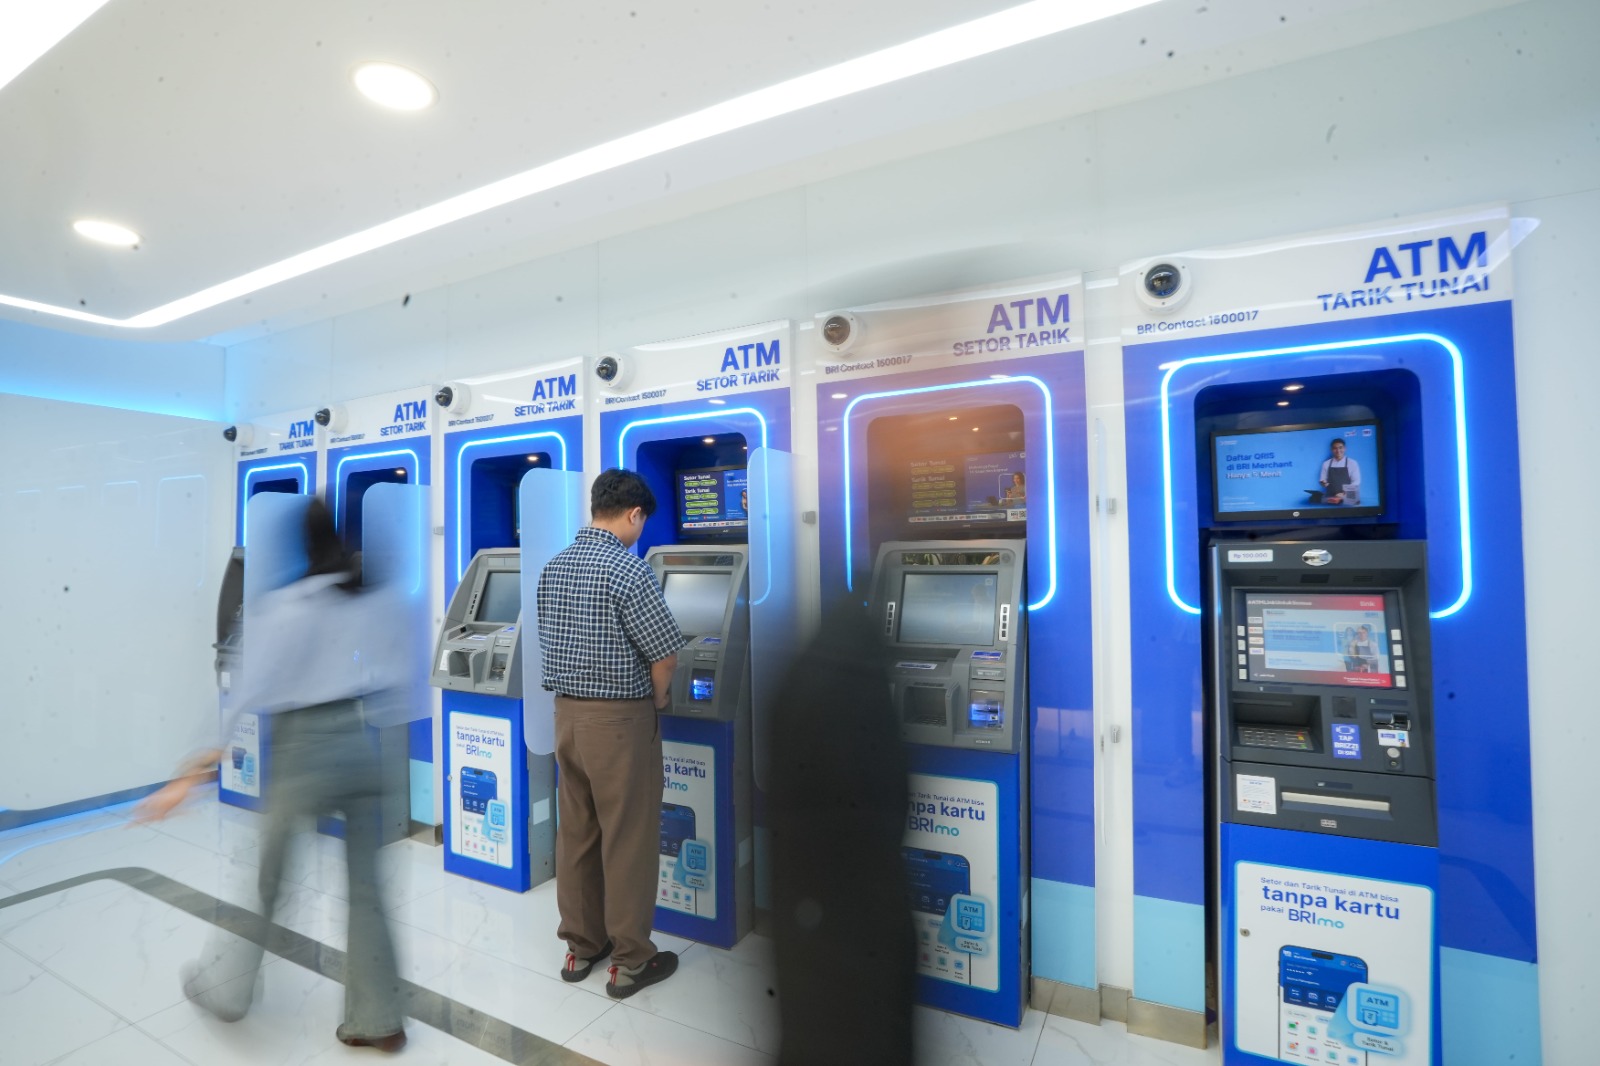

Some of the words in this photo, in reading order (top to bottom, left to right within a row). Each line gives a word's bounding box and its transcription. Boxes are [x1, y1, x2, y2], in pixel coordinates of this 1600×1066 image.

[1364, 231, 1488, 283] ATM
[1317, 285, 1393, 312] TARIK
[1401, 272, 1490, 300] TUNAI
[987, 294, 1070, 334] ATM
[1137, 324, 1156, 334] BRI
[1158, 318, 1206, 332] Contact
[953, 336, 1010, 357] SETOR
[1015, 328, 1071, 349] TARIK
[720, 339, 780, 373] ATM
[825, 365, 839, 374] BRI
[840, 361, 874, 373] Contact
[532, 374, 576, 401] ATM
[696, 375, 738, 392] SETOR
[742, 369, 780, 385] TARIK
[393, 400, 426, 422] ATM
[514, 403, 545, 417] SETOR
[547, 399, 576, 412] TARIK
[288, 420, 314, 439] ATM
[380, 425, 403, 436] SETOR
[405, 421, 426, 432] TARIK
[1226, 454, 1251, 462] Daftar
[1254, 452, 1275, 460] QRIS
[1252, 461, 1293, 469] Merchant
[456, 731, 480, 744] tanpa
[482, 734, 505, 747] kartu
[466, 744, 492, 758] BRImo
[674, 763, 706, 778] kartu
[663, 776, 688, 791] RImo
[941, 802, 985, 821] kartu
[909, 816, 959, 836] BRImo
[1261, 877, 1281, 885] Setor
[1302, 882, 1321, 892] Tarik
[1323, 886, 1346, 895] Tunai
[1358, 891, 1378, 899] ATM
[1380, 894, 1399, 903] bisa
[963, 905, 978, 913] ATM
[1262, 886, 1327, 908] tanpa
[1335, 895, 1399, 920] kartu
[1260, 904, 1284, 913] pakai
[1288, 908, 1344, 929] BRImo
[1366, 996, 1389, 1007] ATM
